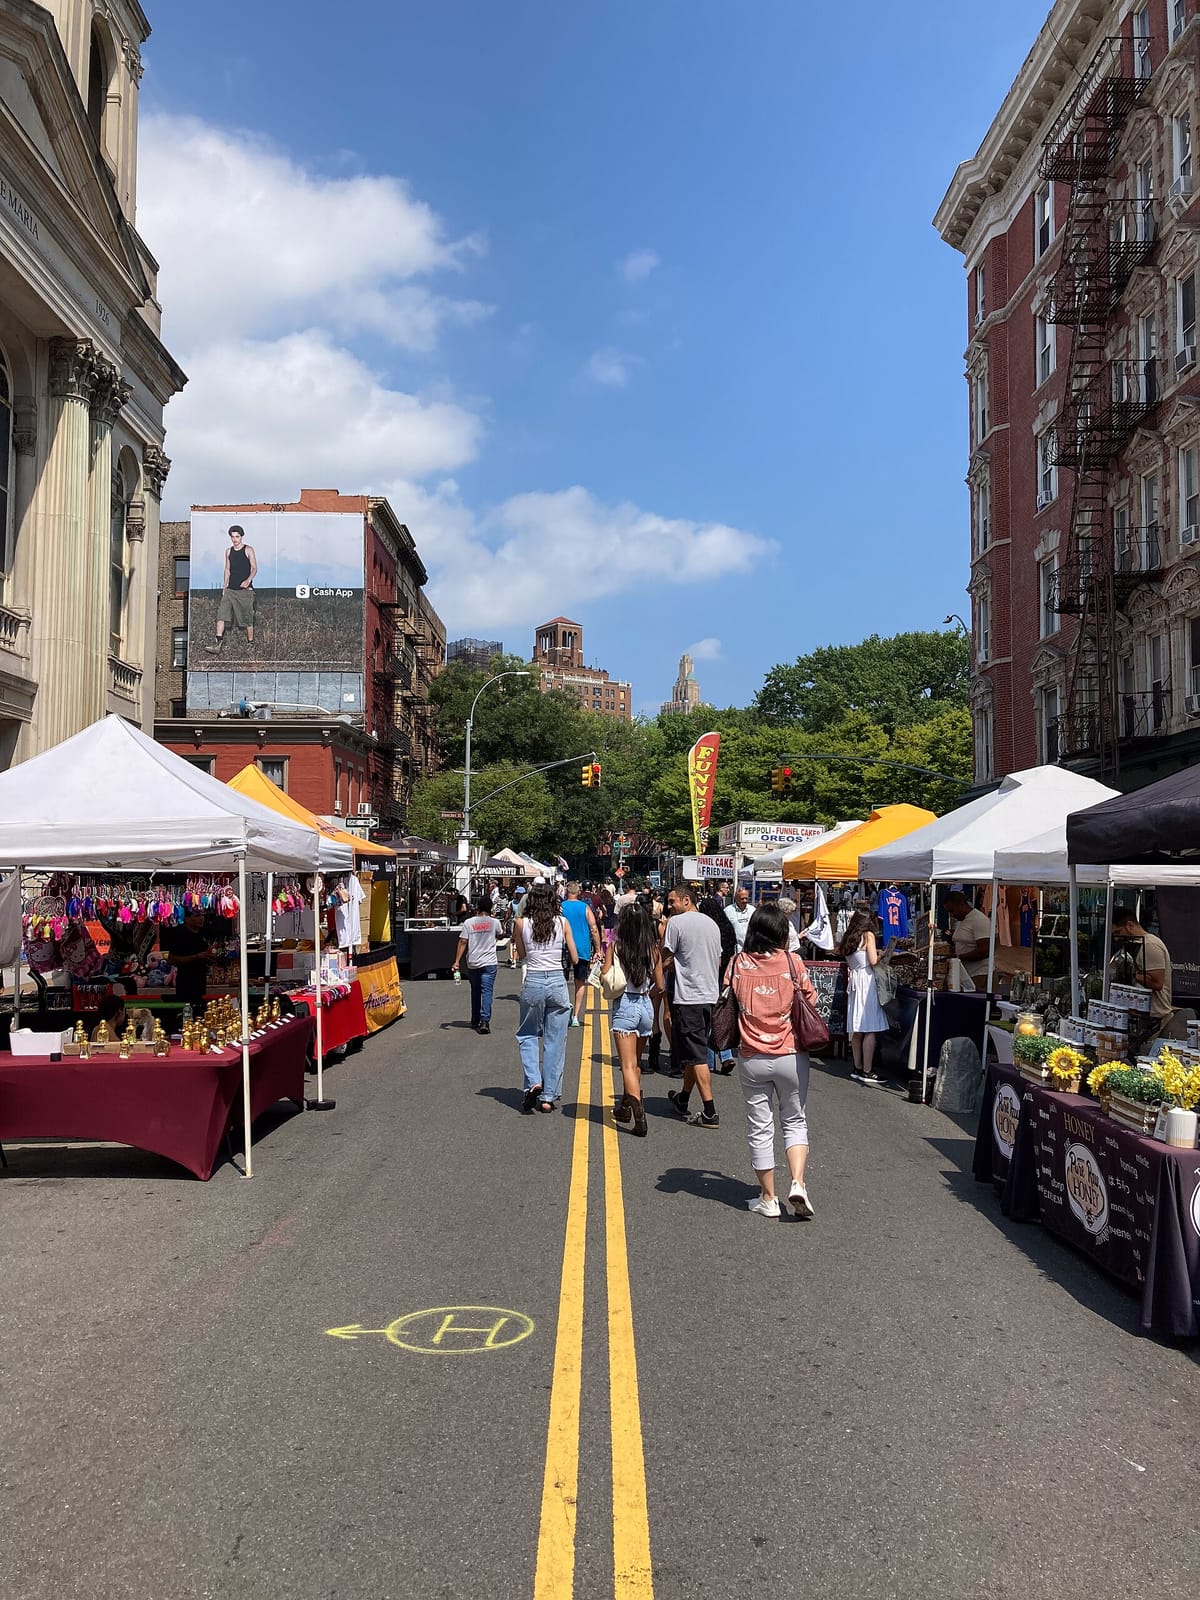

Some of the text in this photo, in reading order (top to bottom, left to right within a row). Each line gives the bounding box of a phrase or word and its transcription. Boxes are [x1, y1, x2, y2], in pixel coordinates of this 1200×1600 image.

[8, 189, 40, 241] MARIA
[95, 299, 110, 327] 1926
[312, 588, 334, 596] Cash
[335, 588, 354, 598] App
[744, 827, 772, 835] ZEPPOLI
[775, 827, 800, 836] FUNNEL
[760, 834, 803, 843] OREOS
[702, 866, 720, 876] FRIED
[715, 858, 733, 868] CAKE
[888, 906, 900, 925] 12
[1063, 1112, 1095, 1144] HONEY
[1072, 1176, 1100, 1209] HONEY
[431, 1314, 509, 1347] H
